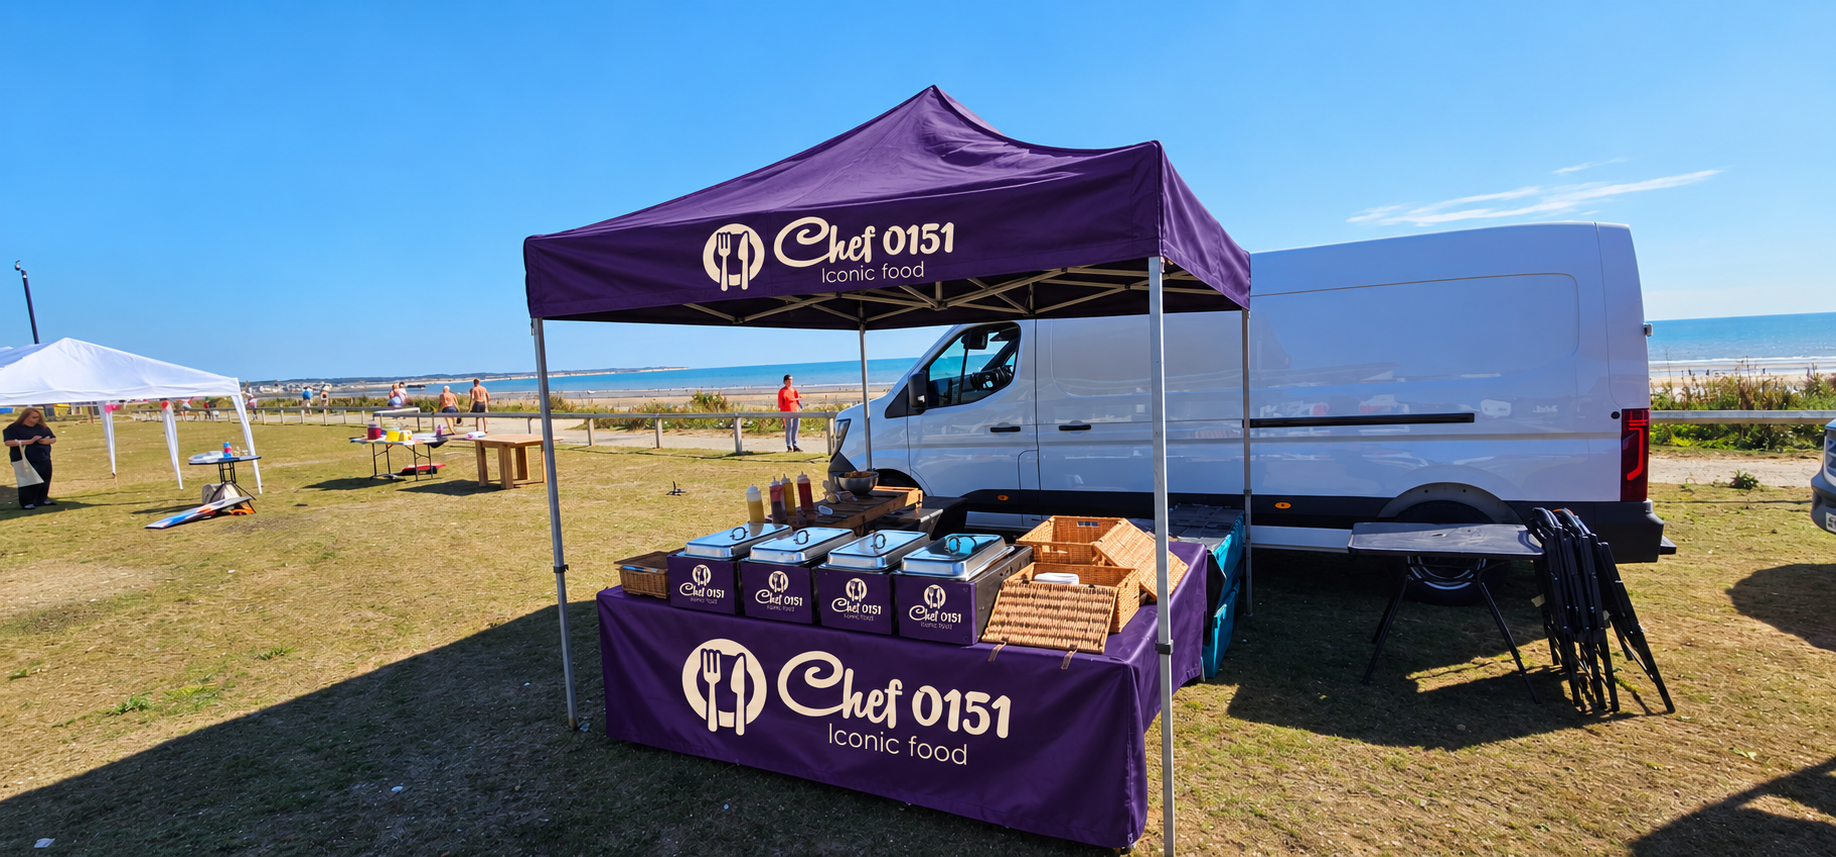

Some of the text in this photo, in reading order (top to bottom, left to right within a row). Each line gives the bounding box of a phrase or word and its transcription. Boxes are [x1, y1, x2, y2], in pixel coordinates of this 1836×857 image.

[773, 216, 955, 268] Chef 0151
[821, 260, 925, 284] Iconic food
[706, 587, 725, 599] 0151
[783, 595, 803, 607] 0151
[861, 603, 882, 615] 0151
[940, 611, 962, 624] 0151
[777, 650, 1012, 739] Chef 0151
[828, 723, 968, 766] Iconic food
